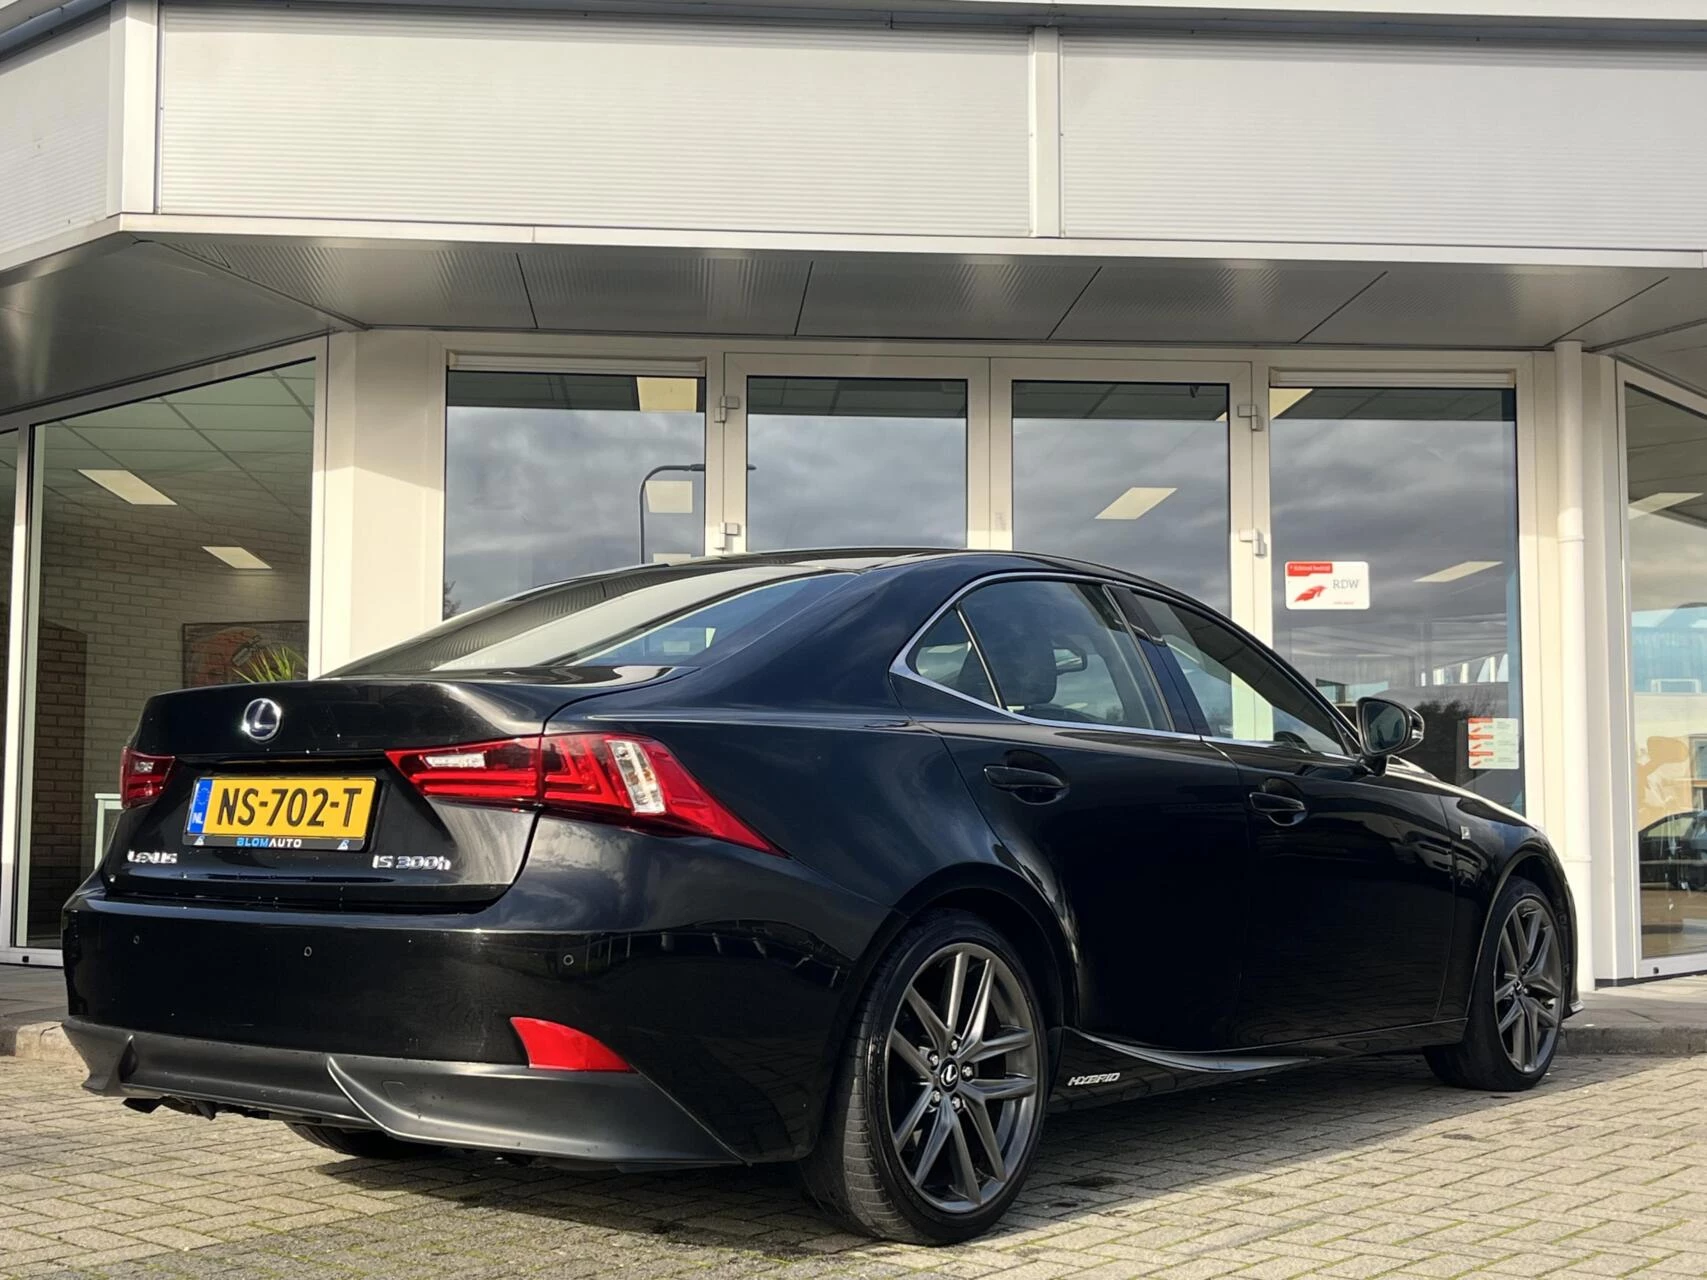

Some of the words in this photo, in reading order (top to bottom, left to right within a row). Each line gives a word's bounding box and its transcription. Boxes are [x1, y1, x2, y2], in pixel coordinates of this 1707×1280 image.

[1332, 579, 1359, 589] RDW
[216, 787, 363, 828] NS-702-T
[191, 812, 203, 824] NL
[236, 837, 302, 848] BLOMAUTO
[127, 850, 178, 864] LEXUS
[372, 854, 393, 868] IS
[396, 855, 451, 870] 300h
[1067, 1072, 1120, 1086] HYBRID
